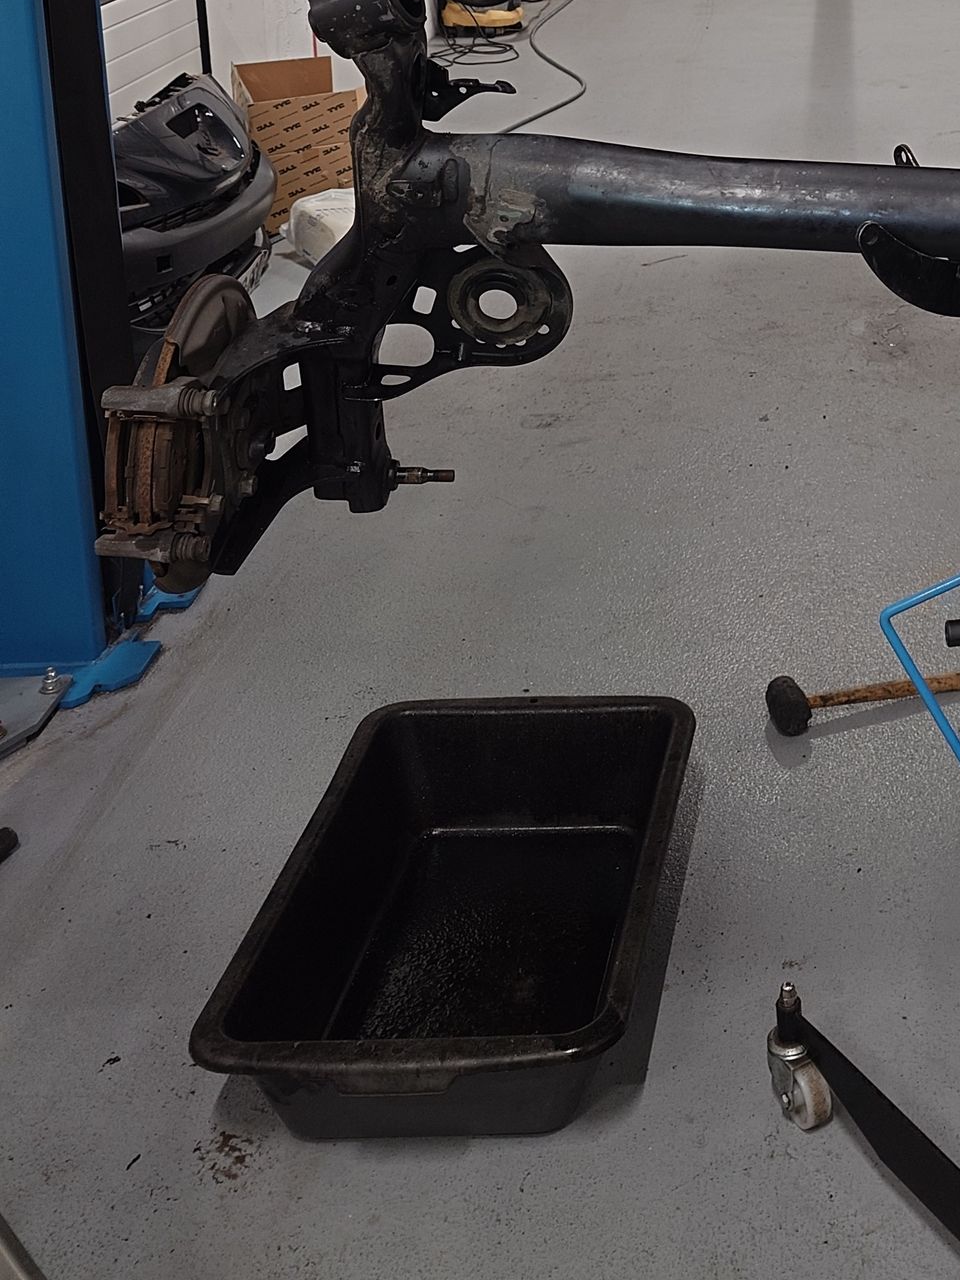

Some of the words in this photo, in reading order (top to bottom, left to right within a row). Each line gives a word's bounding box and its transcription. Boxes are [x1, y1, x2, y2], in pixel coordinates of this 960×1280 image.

[273, 99, 291, 109] TYC
[327, 103, 345, 113] TYC
[283, 122, 301, 132] TYC
[303, 166, 322, 176] TYC
[271, 208, 289, 218] TYC
